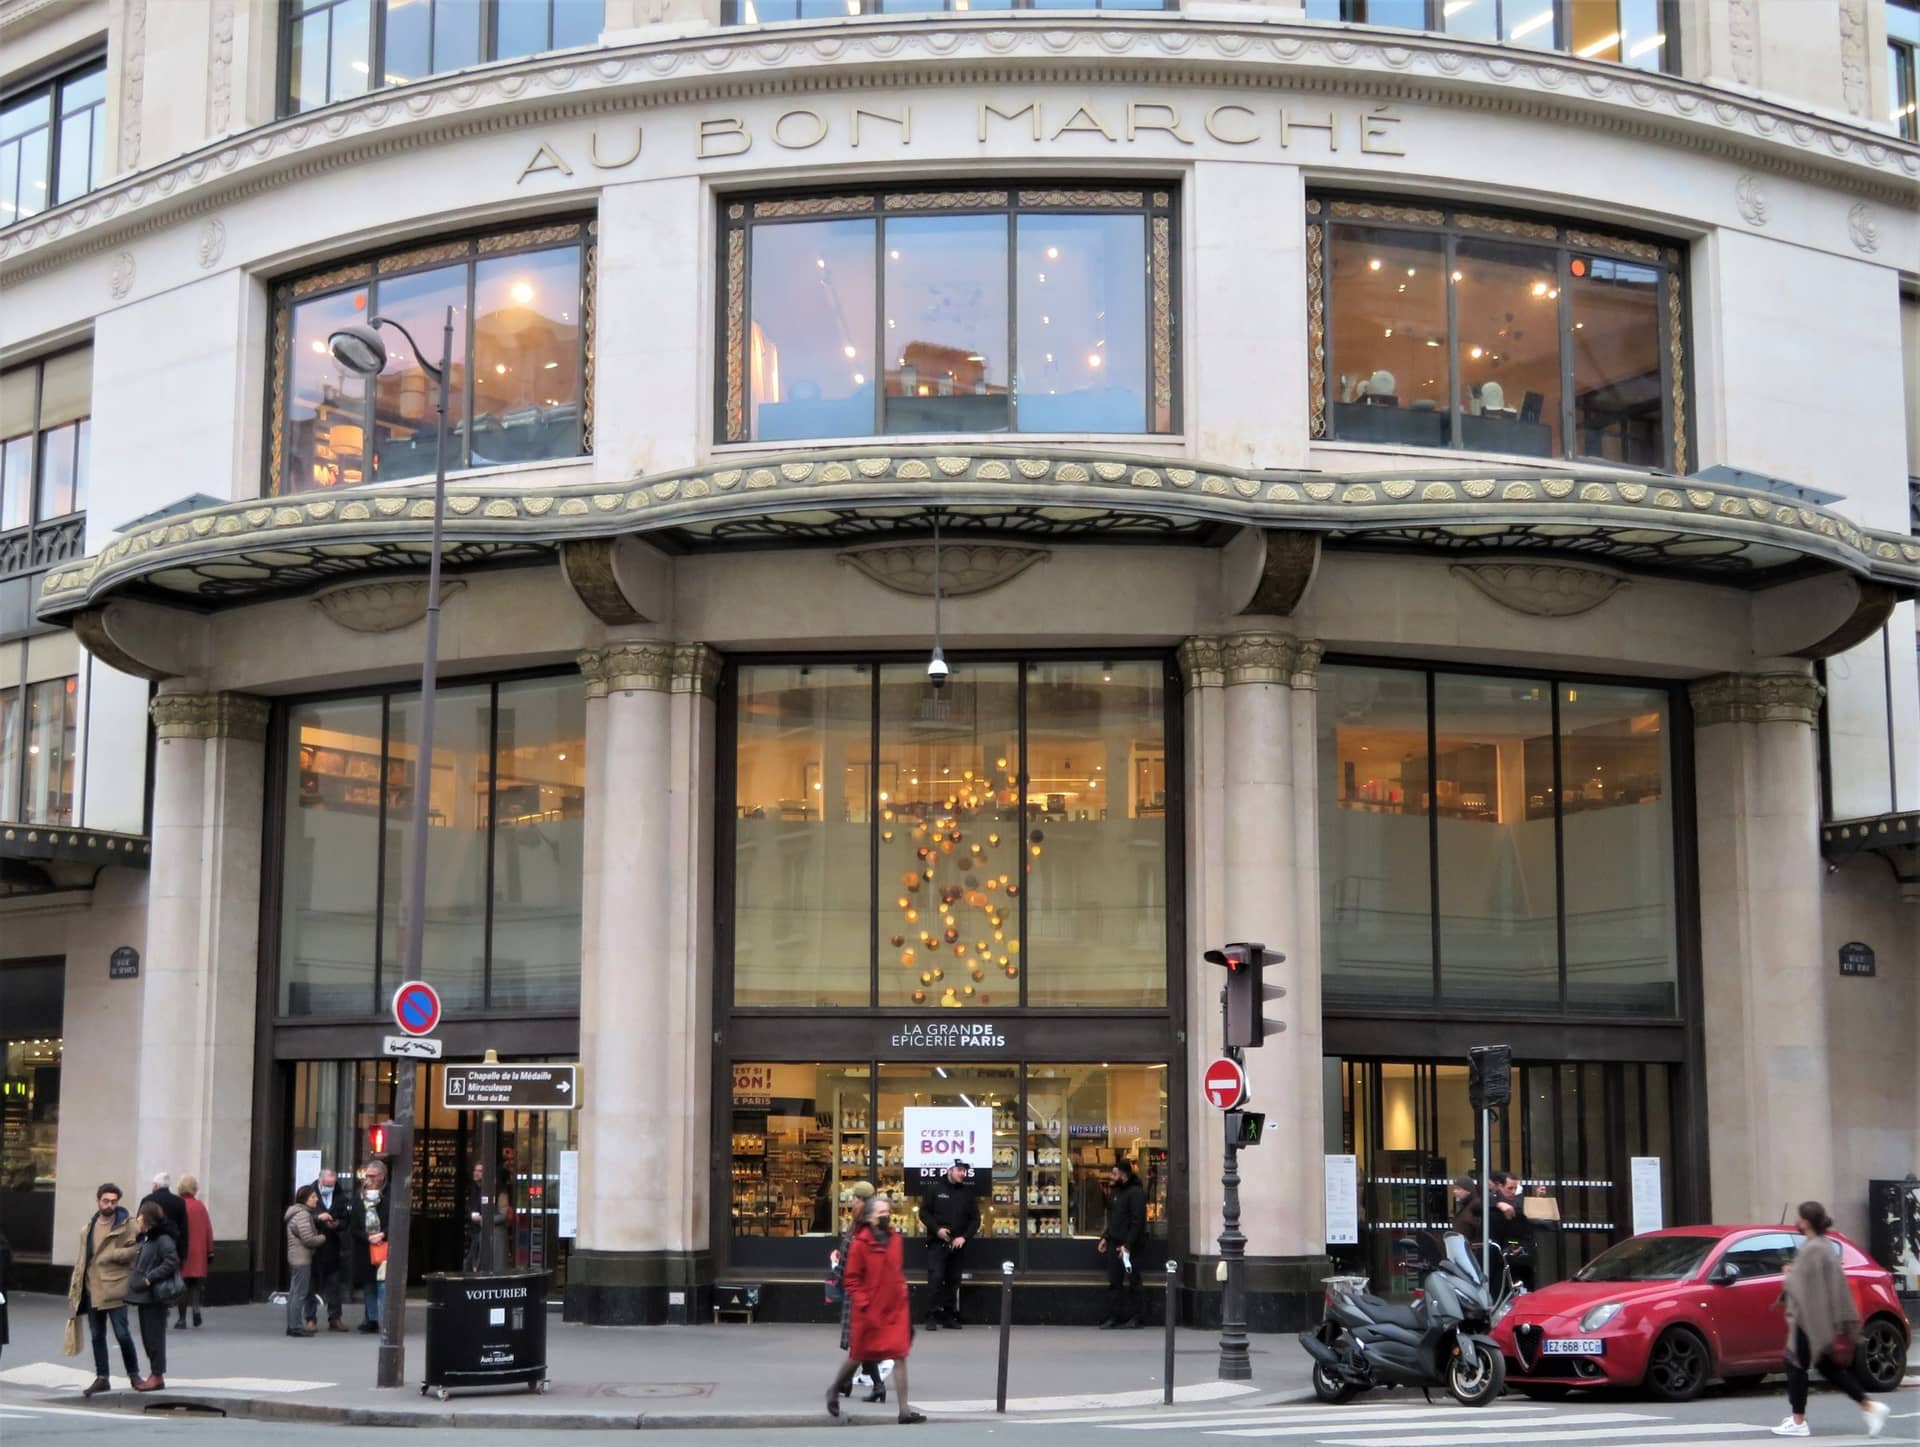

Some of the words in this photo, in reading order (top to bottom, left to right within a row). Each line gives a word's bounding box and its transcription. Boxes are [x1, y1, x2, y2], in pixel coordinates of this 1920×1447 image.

[517, 126, 642, 184] AU
[695, 104, 911, 160] BON
[977, 103, 1406, 157] MARCHÉ
[904, 1024, 922, 1035] LA
[927, 1024, 993, 1035] GRANDE
[892, 1035, 956, 1047] EPICERIE
[961, 1035, 1006, 1047] PARIS
[468, 1071, 500, 1081] Chapelle
[501, 1071, 511, 1080] de
[512, 1071, 519, 1080] la
[520, 1071, 552, 1080] Médaille
[468, 1083, 512, 1092] Miraculeuse
[490, 1094, 497, 1102] du
[920, 1129, 950, 1138] C'EST
[953, 1129, 964, 1138] SI
[920, 1168, 936, 1177] DE
[466, 1287, 528, 1300] VOITURIER
